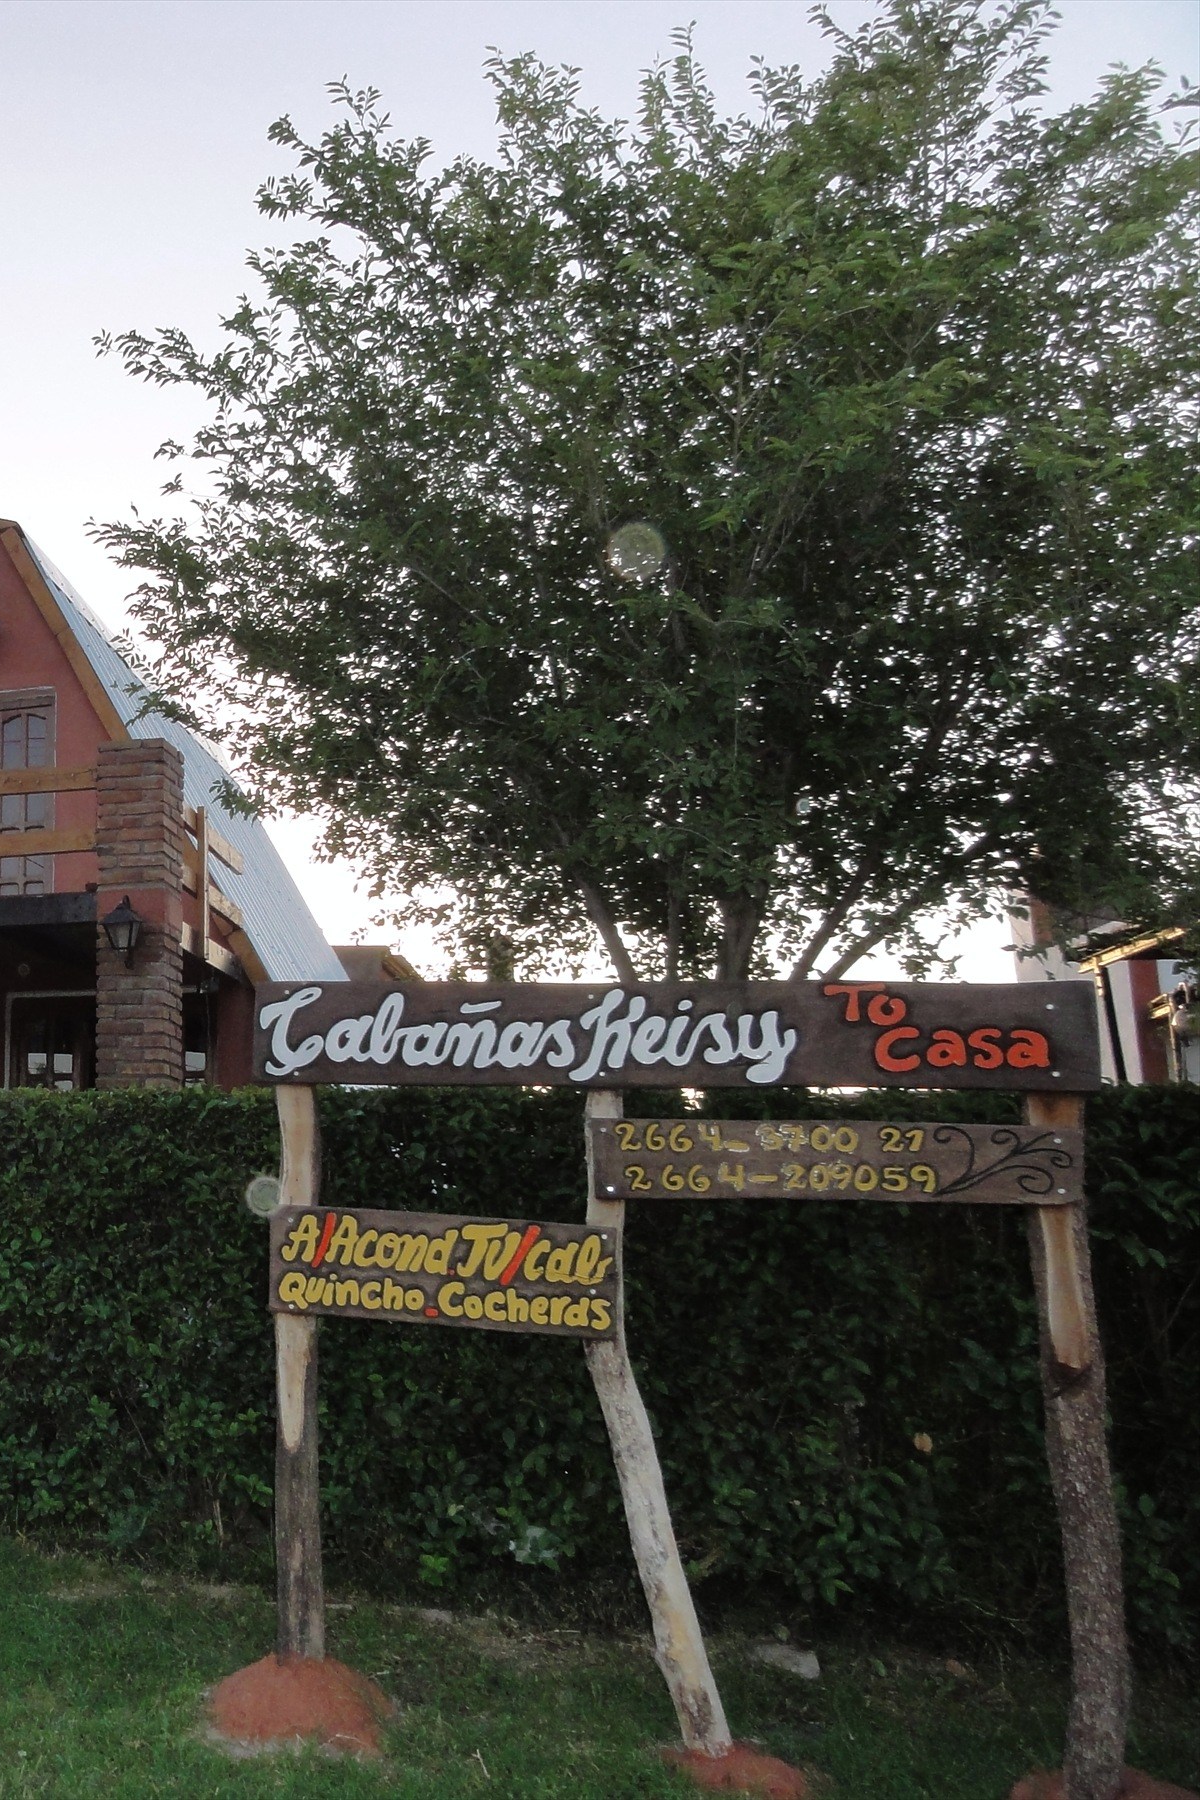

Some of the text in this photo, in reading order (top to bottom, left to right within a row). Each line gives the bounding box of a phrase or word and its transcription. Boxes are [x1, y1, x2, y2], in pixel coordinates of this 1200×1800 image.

[259, 987, 575, 1076] Cabañas
[874, 1027, 1051, 1072] Casa
[437, 1281, 612, 1330] Cocheras
